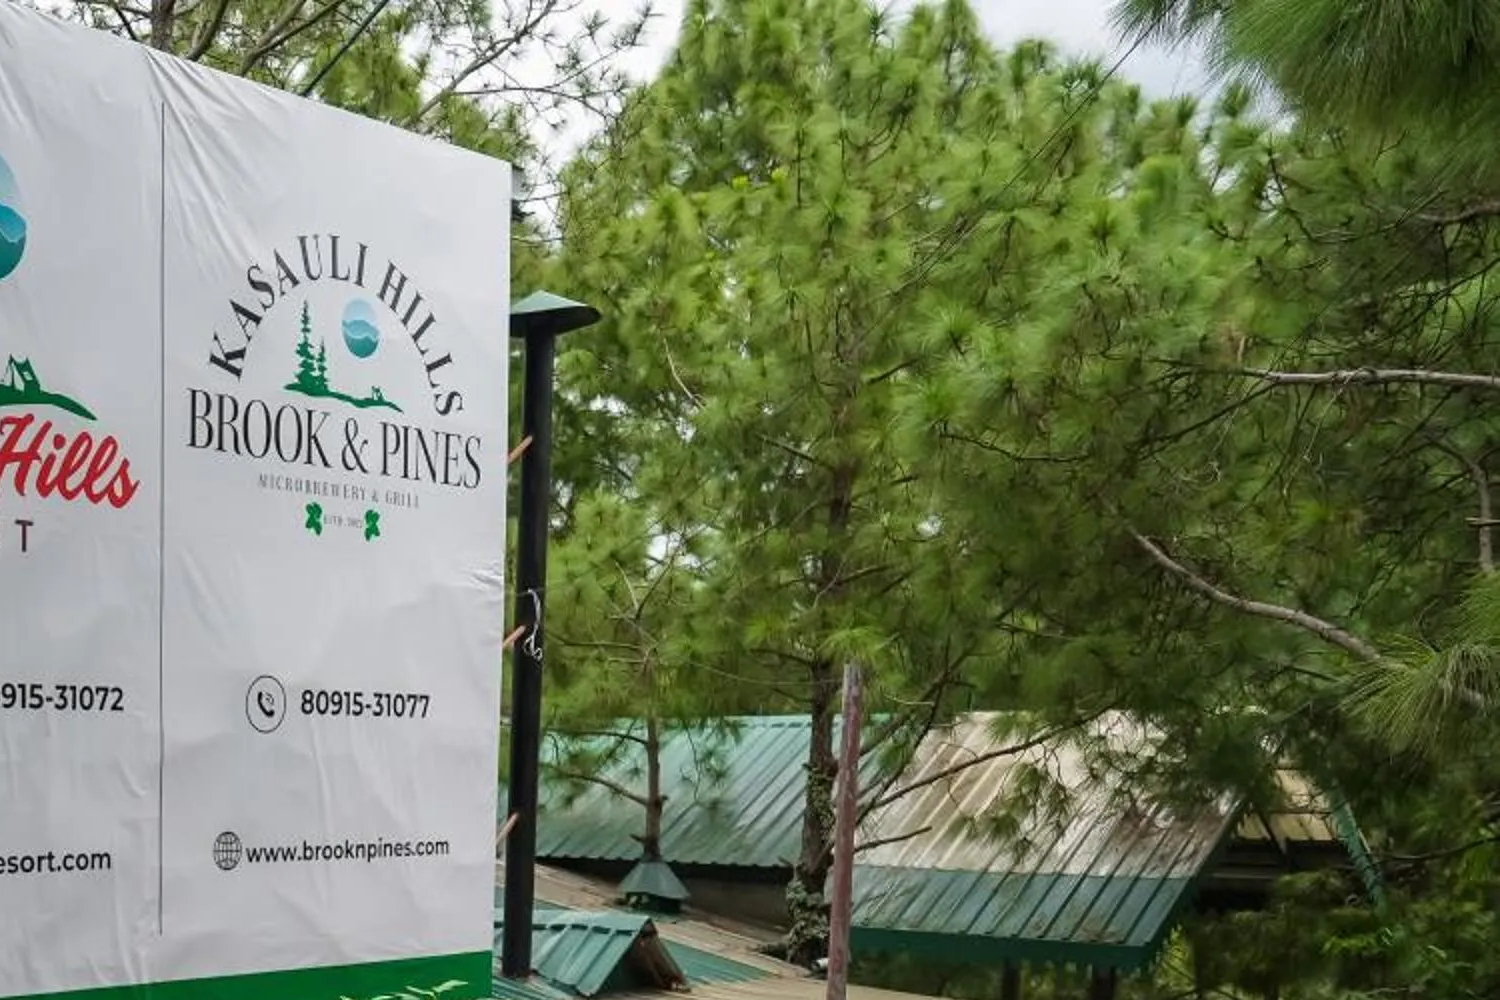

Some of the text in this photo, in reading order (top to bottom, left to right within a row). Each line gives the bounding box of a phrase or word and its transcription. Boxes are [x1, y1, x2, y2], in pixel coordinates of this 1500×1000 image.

[208, 234, 464, 417] KASAULI HILLS
[186, 387, 482, 489] BROOK & PINES
[300, 689, 431, 718] 80915-31077
[246, 837, 450, 863] www.brooknpines.com
